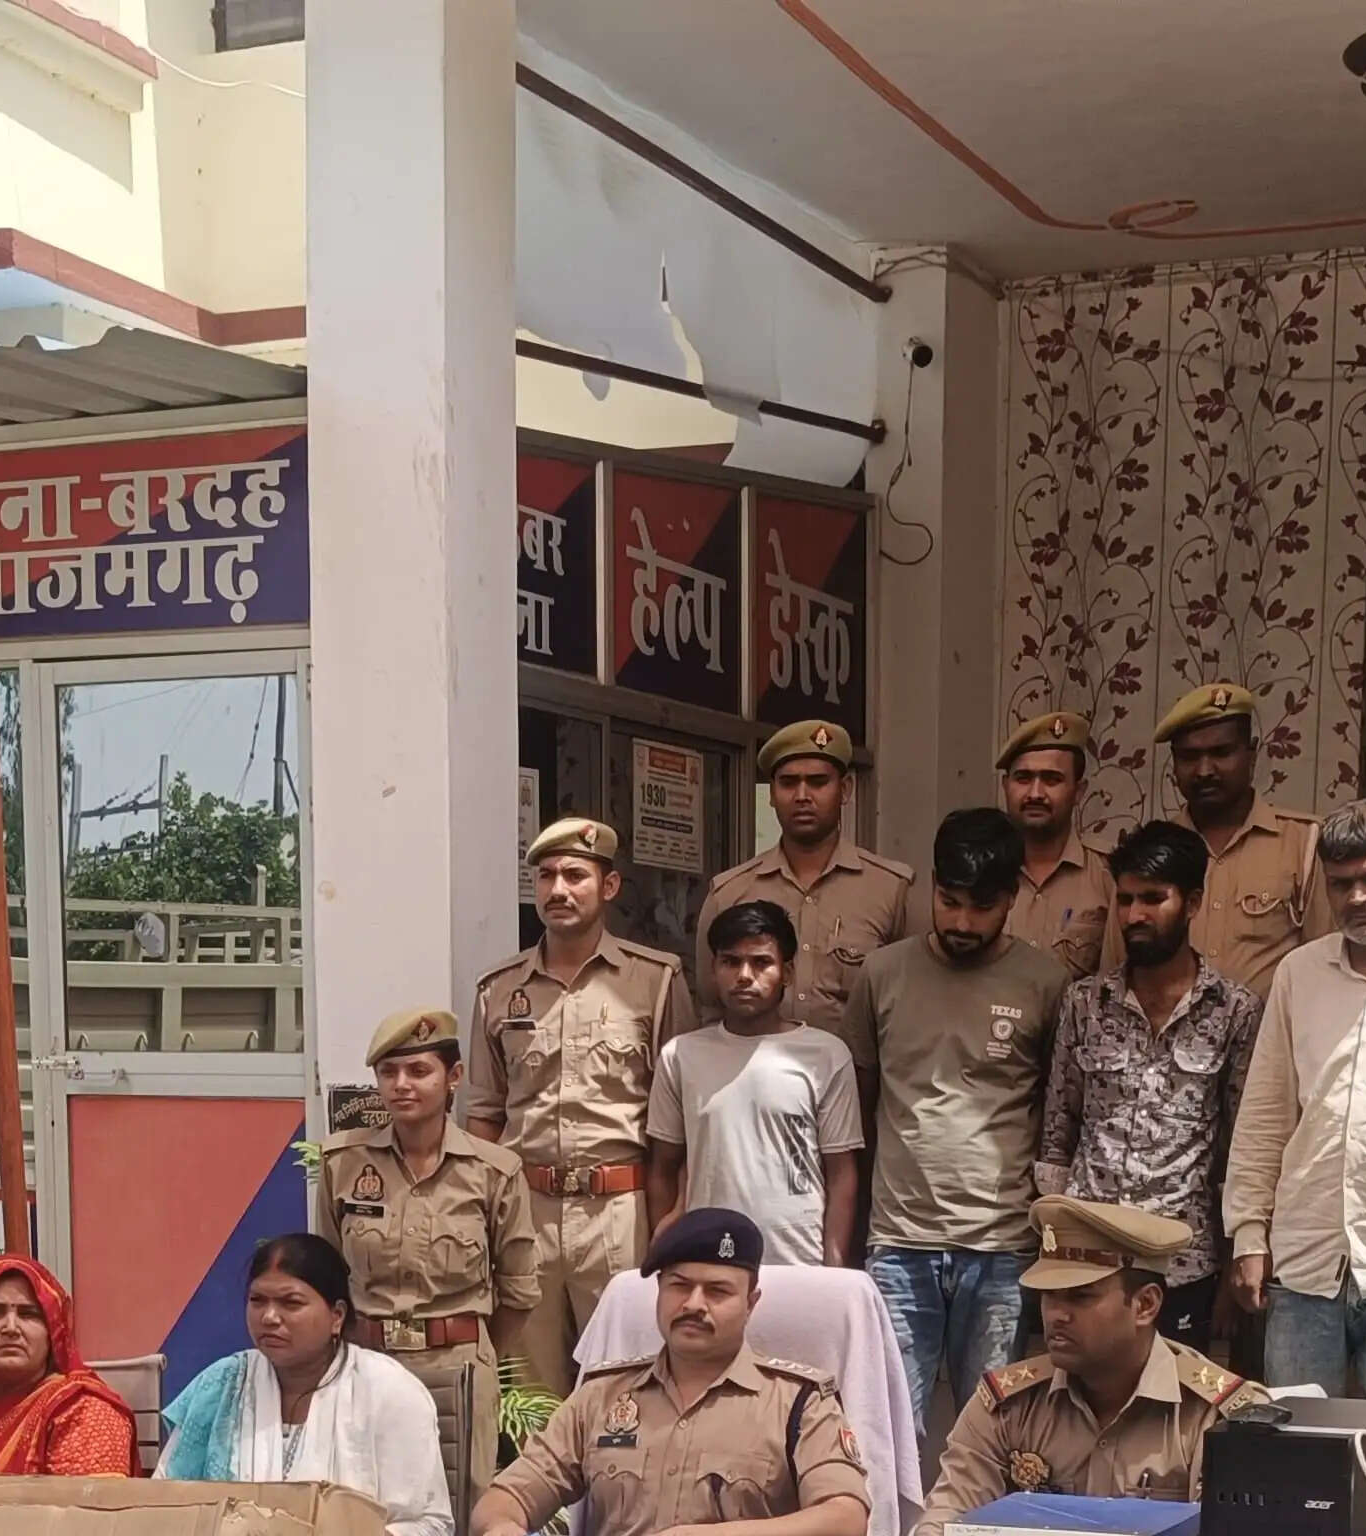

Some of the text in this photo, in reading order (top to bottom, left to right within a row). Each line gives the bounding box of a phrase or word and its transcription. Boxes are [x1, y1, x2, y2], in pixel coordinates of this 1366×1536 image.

[626, 506, 727, 674] हेल्प
[765, 528, 854, 704] डेस्क
[640, 781, 667, 808] 1930
[990, 1004, 1022, 1019] TEXAS
